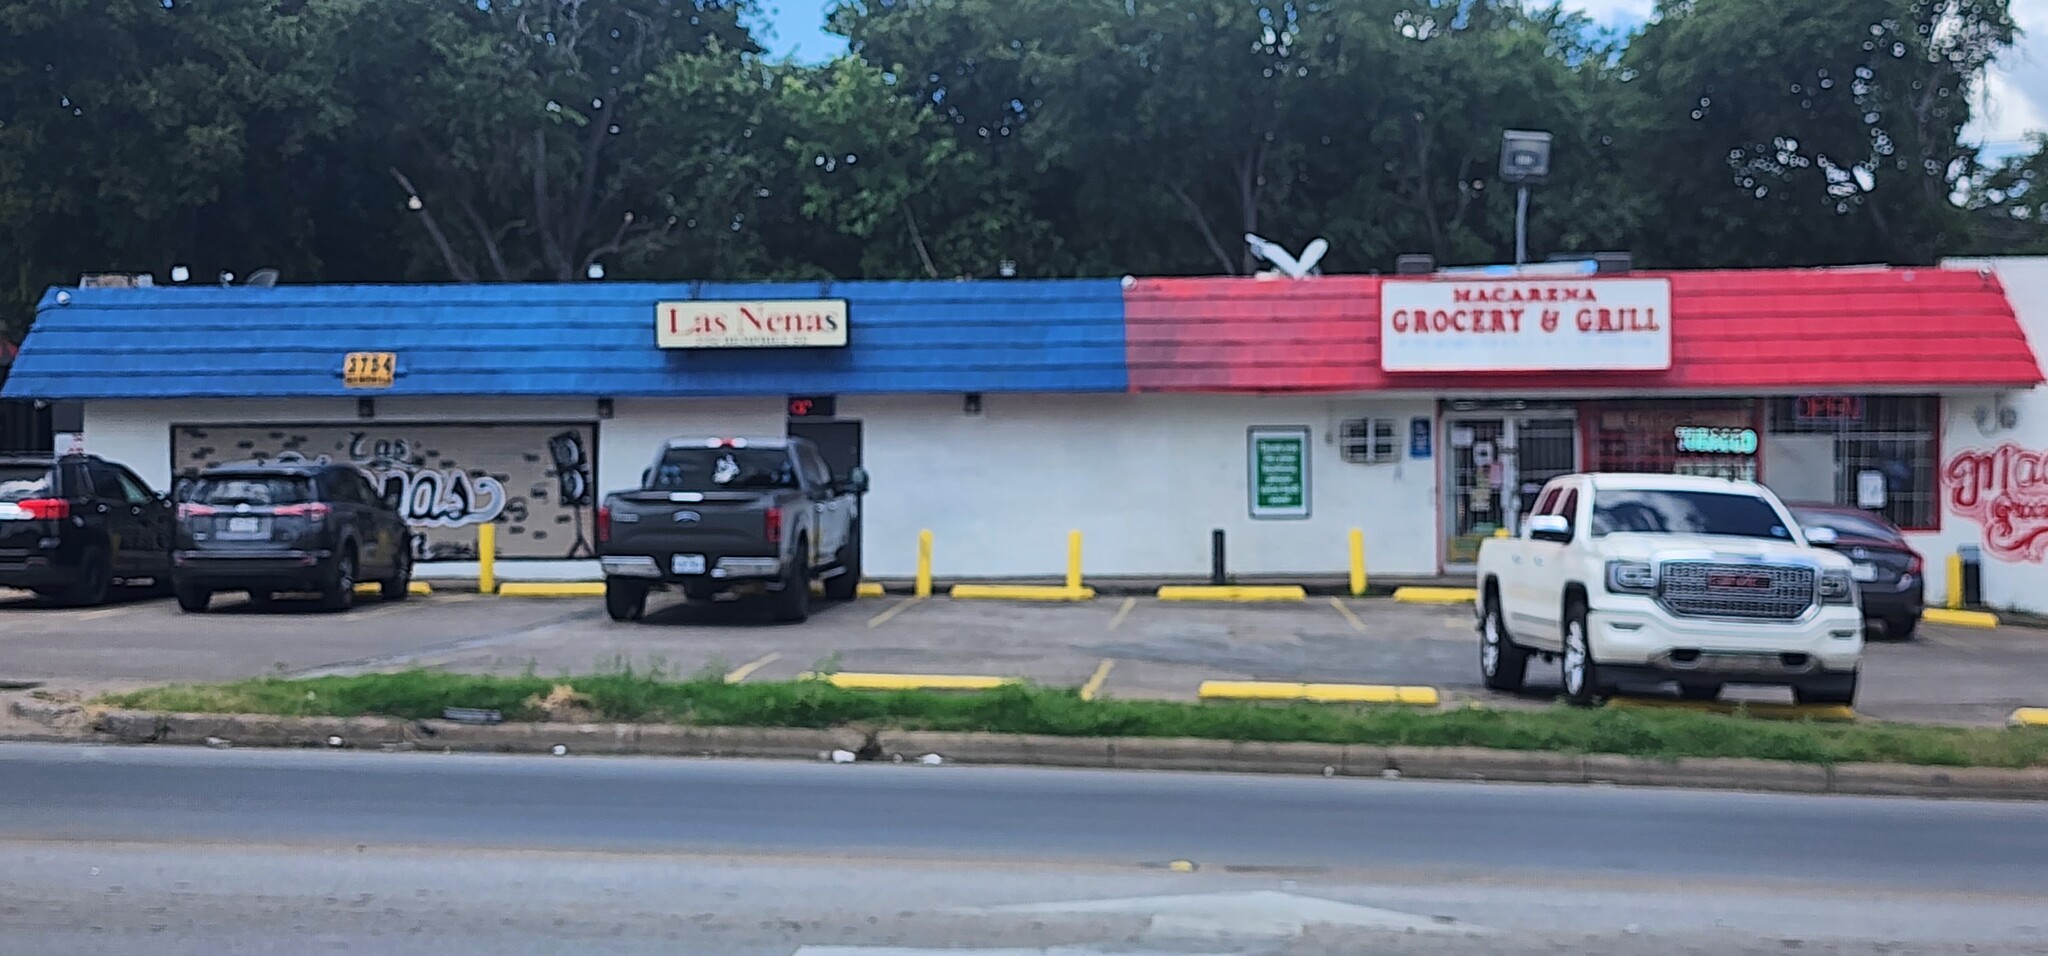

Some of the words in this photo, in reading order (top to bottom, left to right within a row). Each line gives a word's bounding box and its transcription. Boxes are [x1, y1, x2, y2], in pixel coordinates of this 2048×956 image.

[1453, 287, 1598, 303] MACARENA
[668, 307, 728, 335] Las
[736, 307, 840, 335] Nenas
[1392, 308, 1524, 333] GROCERY
[1541, 308, 1560, 333] &
[1575, 307, 1661, 333] GRILL
